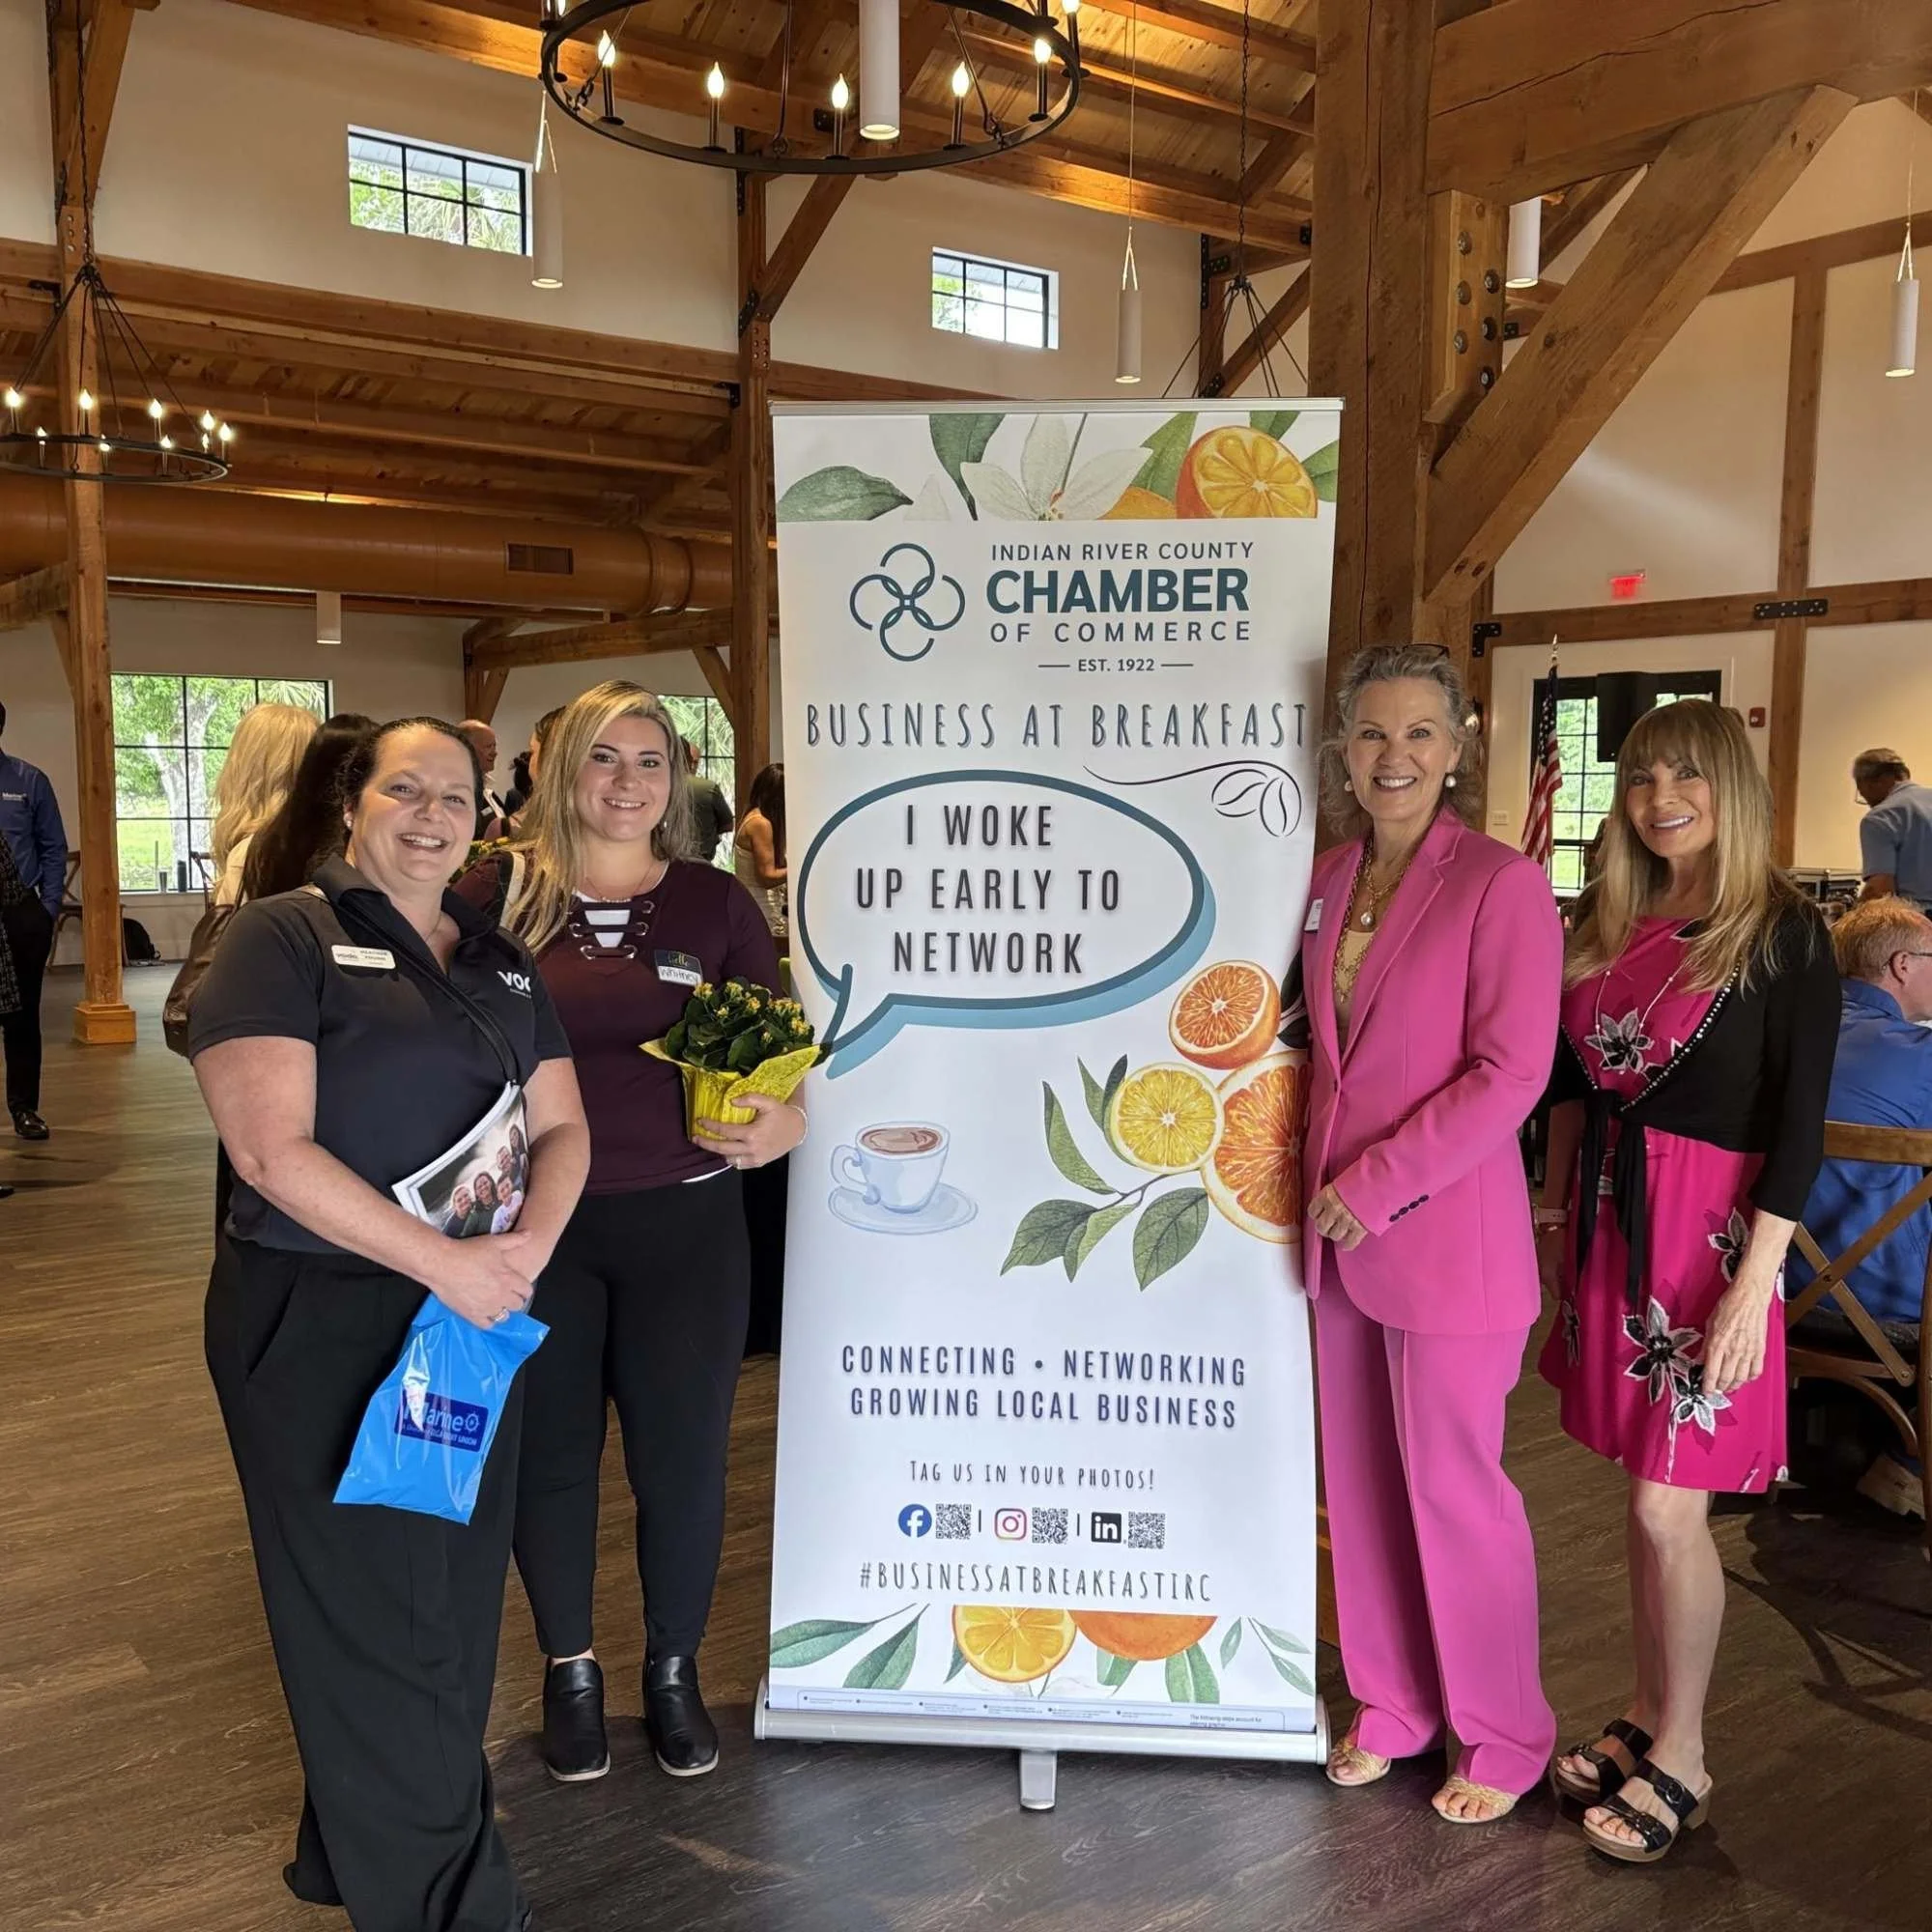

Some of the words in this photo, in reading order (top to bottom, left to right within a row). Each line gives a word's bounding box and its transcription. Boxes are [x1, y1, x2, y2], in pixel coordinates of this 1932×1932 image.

[991, 544, 1071, 561] INDIAN
[1082, 543, 1149, 560] RIVER
[1158, 541, 1255, 560] COUNTY
[985, 567, 1250, 614] CHAMBER
[990, 622, 1031, 643] OF
[1054, 620, 1251, 643] COMMERCE
[1077, 658, 1111, 672] EST.
[1118, 658, 1155, 672] 1922
[806, 702, 996, 749] BUSINESS
[1022, 702, 1065, 749] AT
[1091, 701, 1306, 749] BREAKFAST
[905, 804, 914, 847] I
[943, 804, 1052, 847] WOKE
[856, 867, 903, 910] UP
[930, 867, 1052, 911] EARLY
[1077, 868, 1120, 913] TO
[894, 931, 1083, 975] NETWORK
[841, 1345, 1014, 1377] CONNECTING
[1064, 1349, 1245, 1387] NETWORKING
[850, 1387, 979, 1418] GROWING
[997, 1389, 1079, 1421] LOCAL
[1096, 1393, 1236, 1430] BUSINESS
[860, 1561, 1212, 1603] #BUSINESSATBREAKFASTIRC
